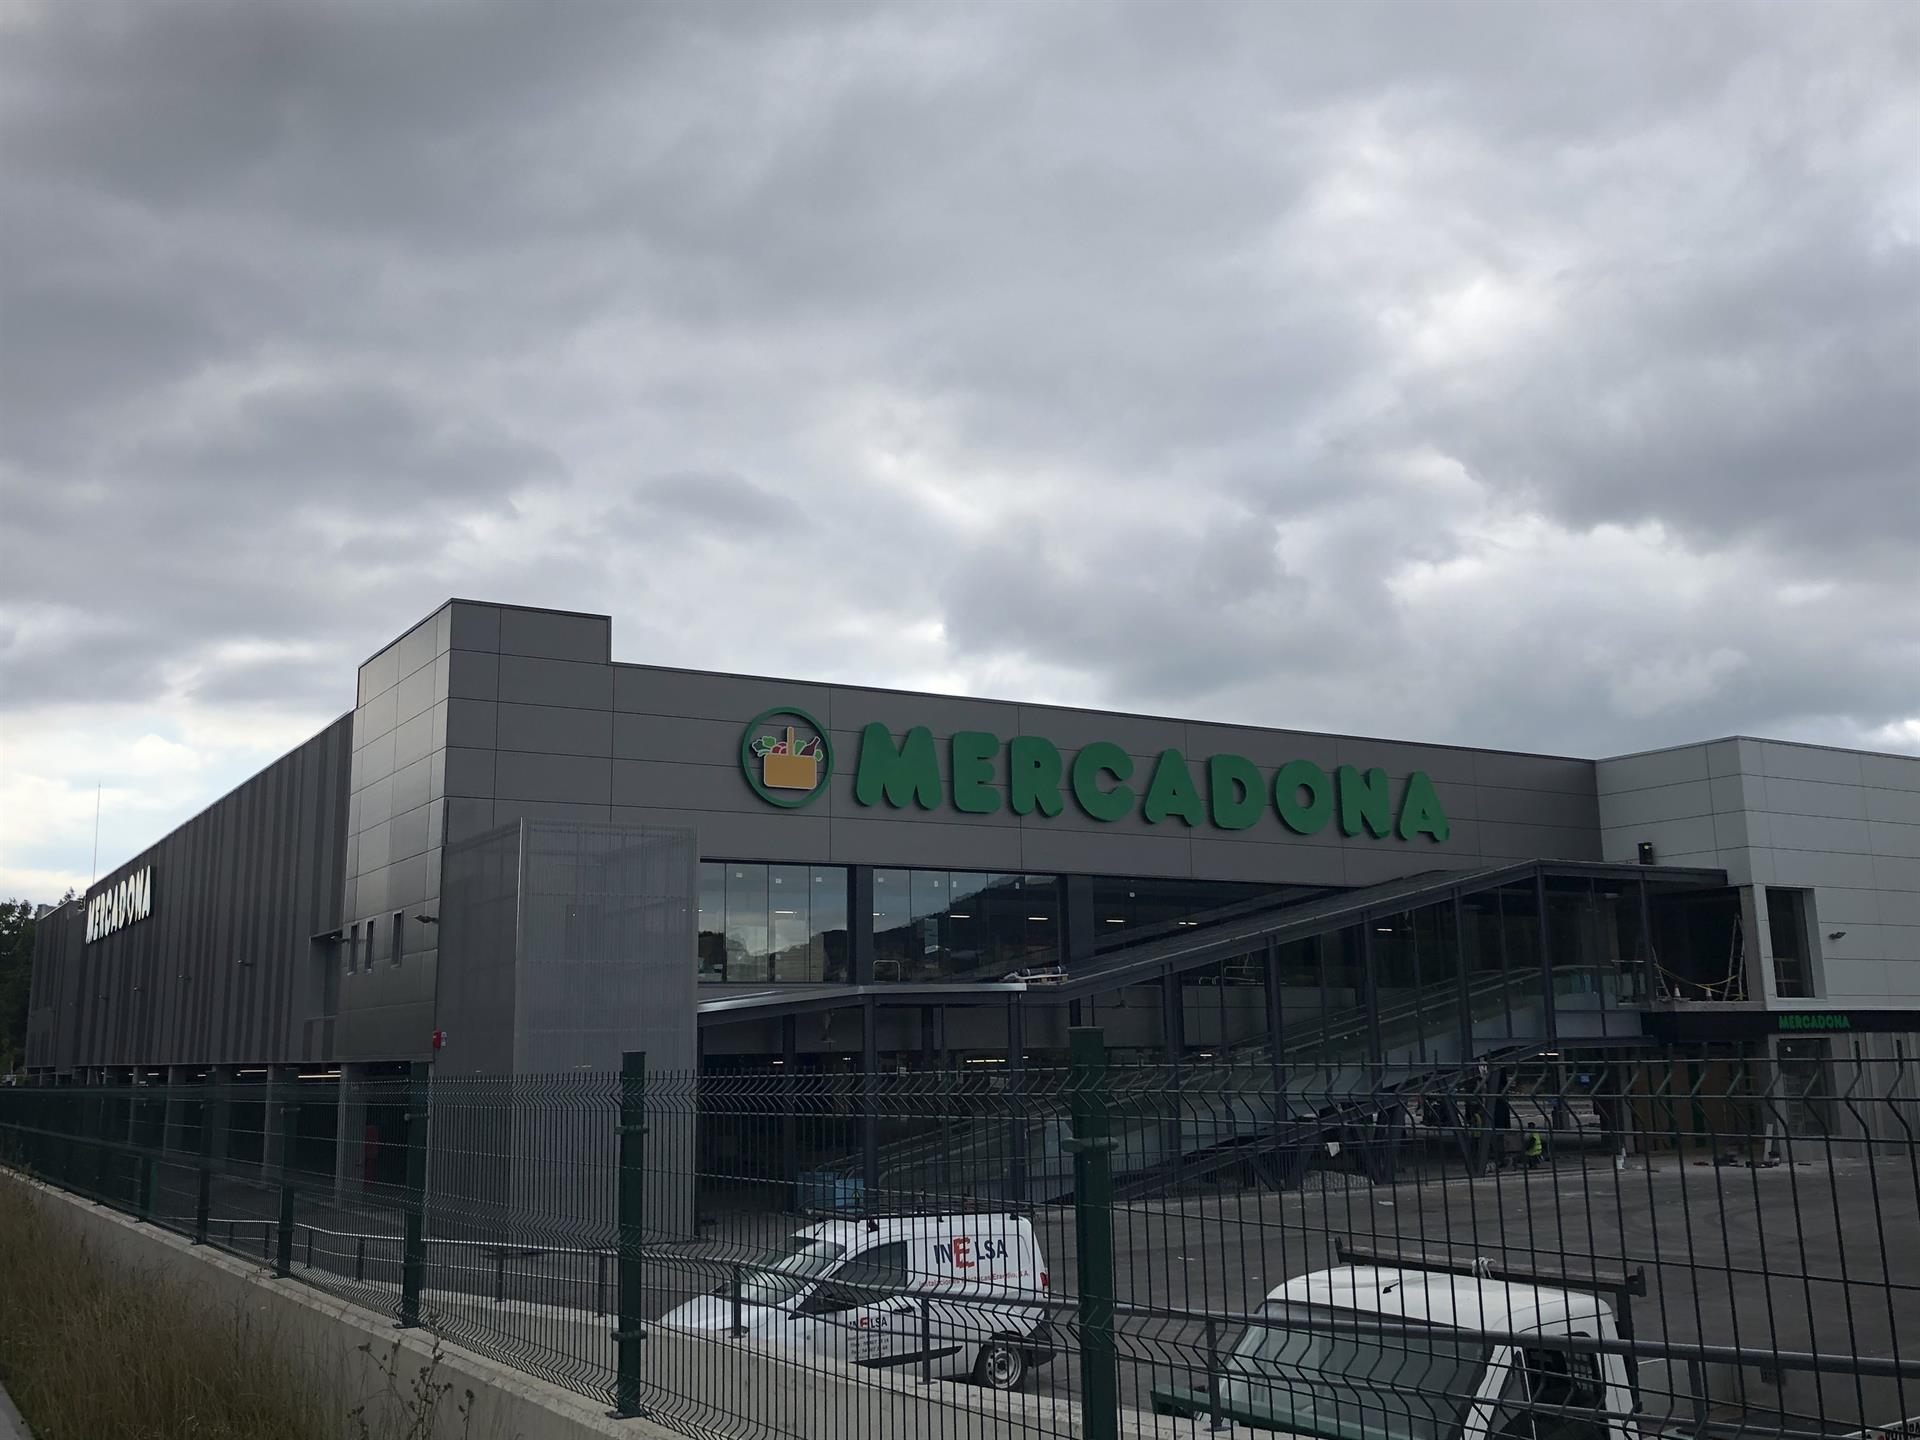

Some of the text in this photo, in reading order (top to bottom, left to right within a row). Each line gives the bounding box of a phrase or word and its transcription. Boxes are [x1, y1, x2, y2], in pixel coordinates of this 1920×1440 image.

[855, 720, 1450, 843] MERCADONA
[85, 864, 151, 945] MERCADONA
[1778, 1015, 1851, 1030] MERCADONA
[933, 1236, 1009, 1269] INELSA
